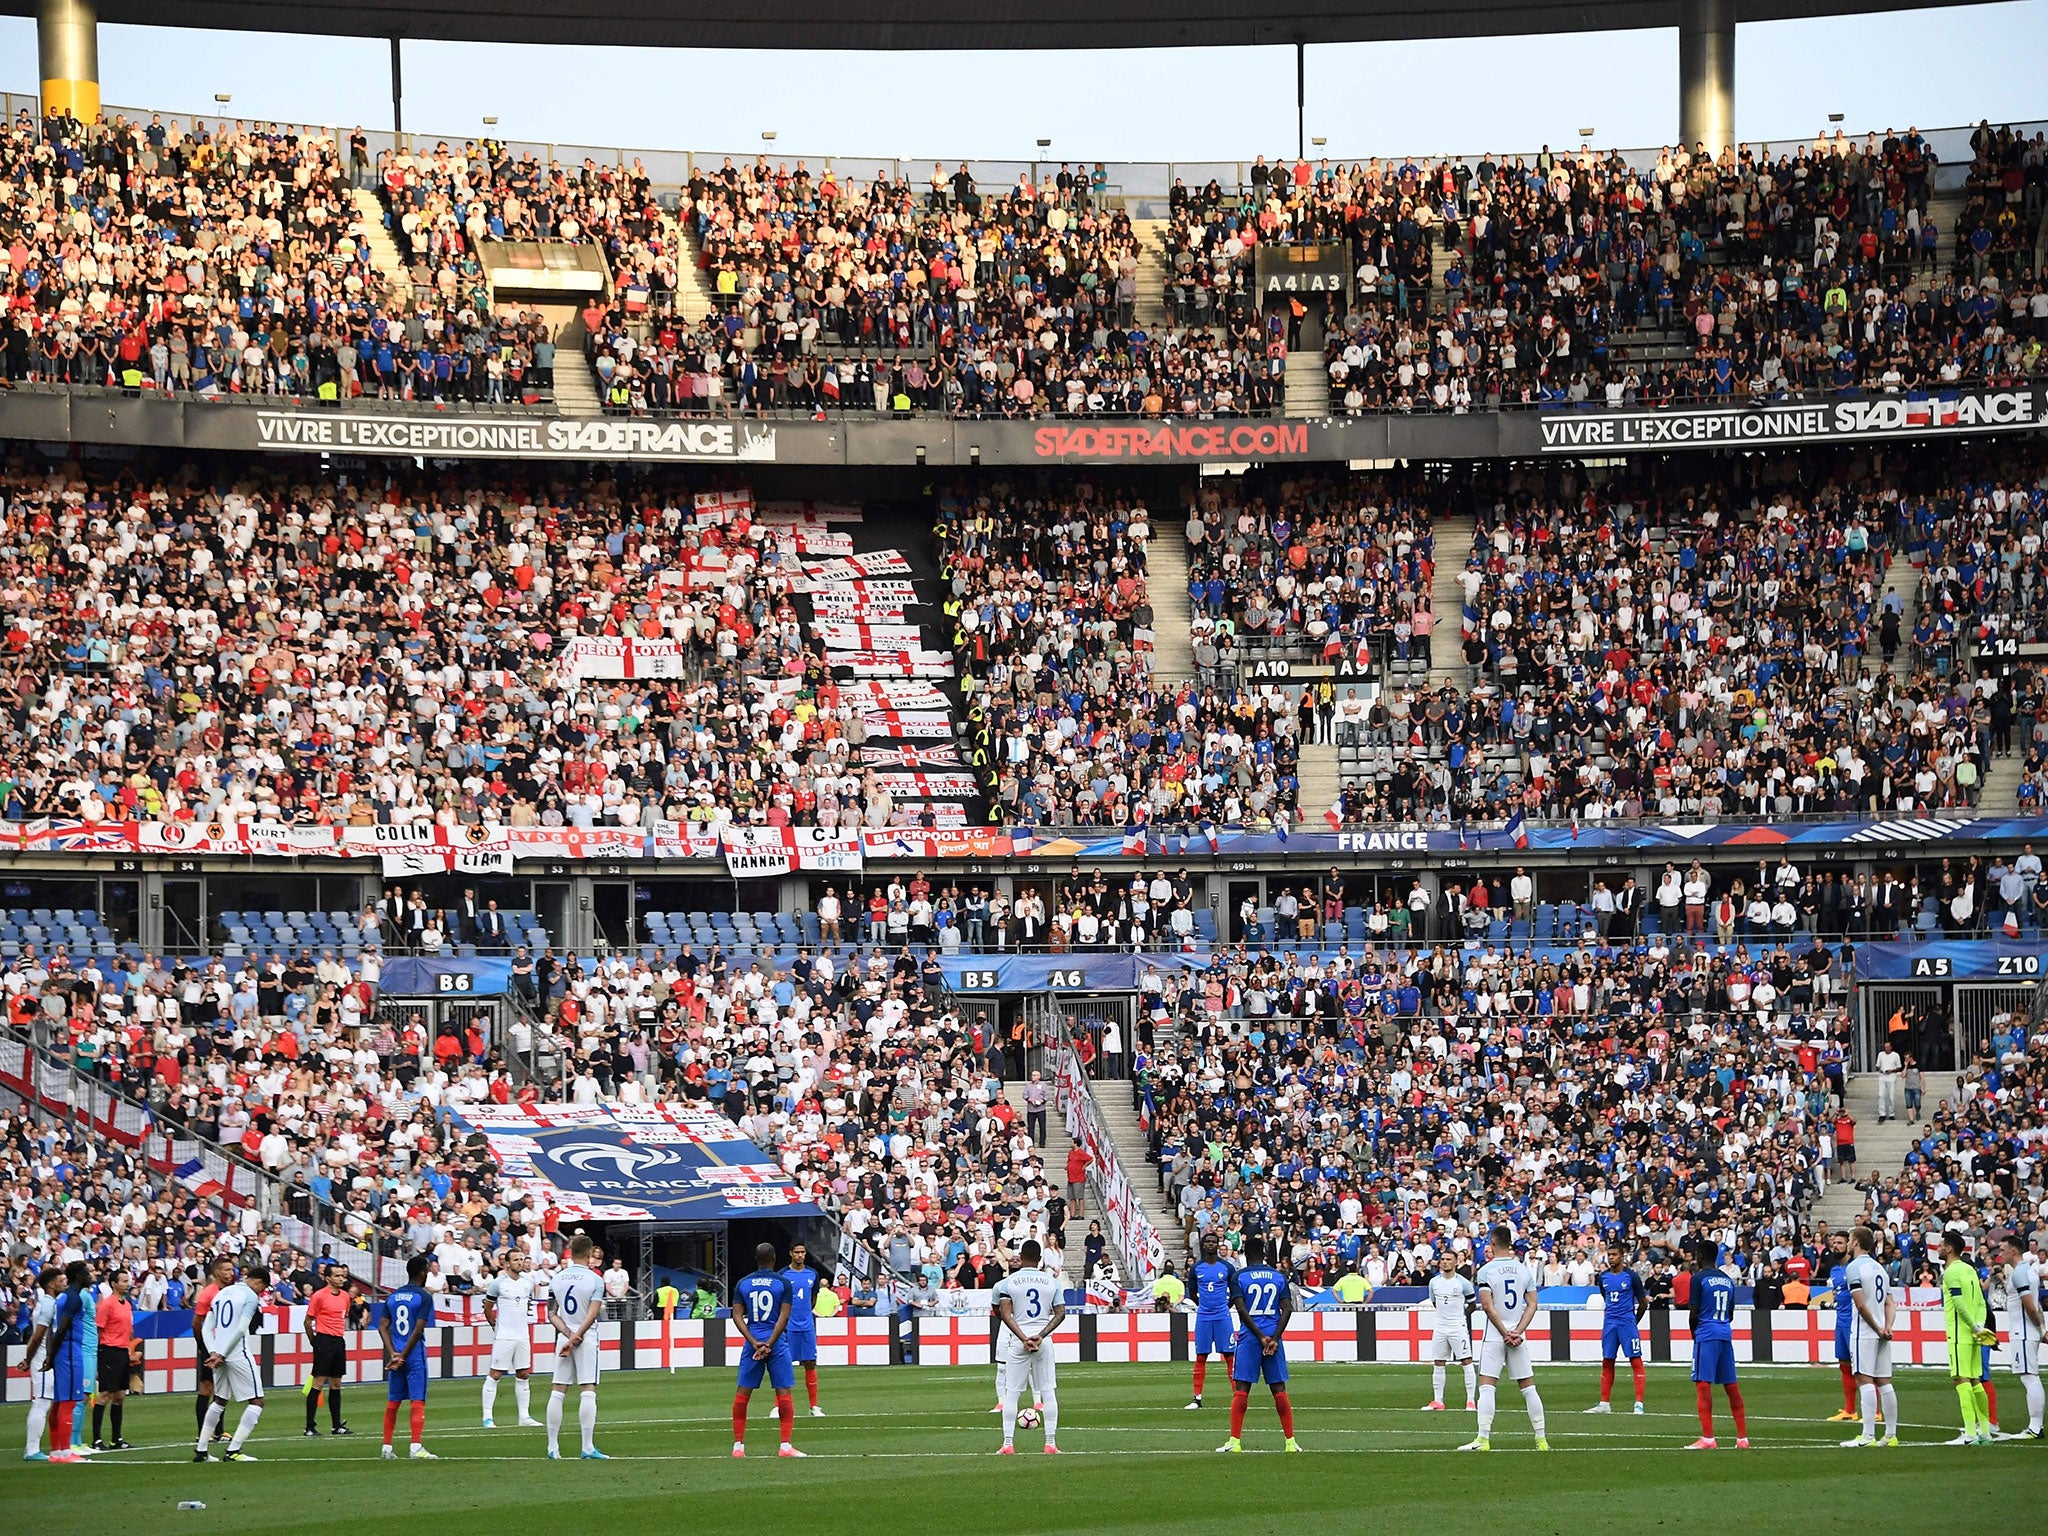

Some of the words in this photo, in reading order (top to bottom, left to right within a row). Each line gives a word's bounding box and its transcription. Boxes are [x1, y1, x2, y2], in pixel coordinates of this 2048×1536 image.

[1268, 275, 1298, 292] A4
[1311, 274, 1340, 292] A3
[257, 418, 332, 443] VIVRE
[340, 421, 544, 450] L'EXCEPTIONNEL
[547, 420, 734, 454] STADEFRANCE
[1541, 421, 1614, 445] VIVRE
[1623, 412, 1830, 442] L'EXCEPTIONNEL
[1034, 424, 1308, 457] STADEFRANCE.COM
[577, 644, 627, 657] DERBY
[632, 645, 680, 657] LOYAL
[1255, 660, 1289, 677] A10
[1340, 659, 1369, 676] A9
[864, 752, 926, 761] CARLISLE
[930, 750, 957, 760] UTD
[881, 780, 957, 789] LACKPOOL
[251, 827, 286, 839] KURT
[375, 825, 429, 841] COLIN
[873, 830, 961, 845] BLACKPOOL
[963, 828, 989, 842] F.C.
[1338, 832, 1429, 851] FRANCE
[817, 855, 845, 868] CITY
[1605, 855, 1618, 865] 48
[1823, 850, 1836, 860] 47
[1884, 849, 1898, 858] 46
[731, 855, 786, 869] HANNAH
[971, 865, 983, 873] 51
[1028, 864, 1040, 873] 50
[1391, 859, 1404, 868] 49
[1915, 958, 1949, 976] A5
[1998, 956, 2039, 974] Z10
[439, 974, 470, 991] B6
[966, 971, 995, 988] B5
[1052, 970, 1082, 987] A6
[579, 1179, 710, 1189] FRANCE
[1012, 1276, 1050, 1287] BERTRAND
[1250, 1271, 1273, 1280] UMTITI
[797, 1287, 804, 1300] 4
[1207, 1281, 1214, 1292] 6
[1504, 1279, 1518, 1310] 5
[1874, 1274, 1884, 1304] 8
[515, 1296, 521, 1306] 9
[564, 1284, 578, 1315] 6
[1026, 1288, 1042, 1318] 3
[1247, 1283, 1278, 1316] 22
[1443, 1295, 1449, 1305] 2
[1610, 1291, 1619, 1302] 12
[749, 1290, 774, 1322] 19
[1713, 1290, 1729, 1321] 11
[215, 1299, 234, 1329] 10
[395, 1304, 410, 1336] 8
[1229, 1333, 1235, 1345] 6
[1461, 1339, 1468, 1350] 2
[1631, 1338, 1640, 1350] 12
